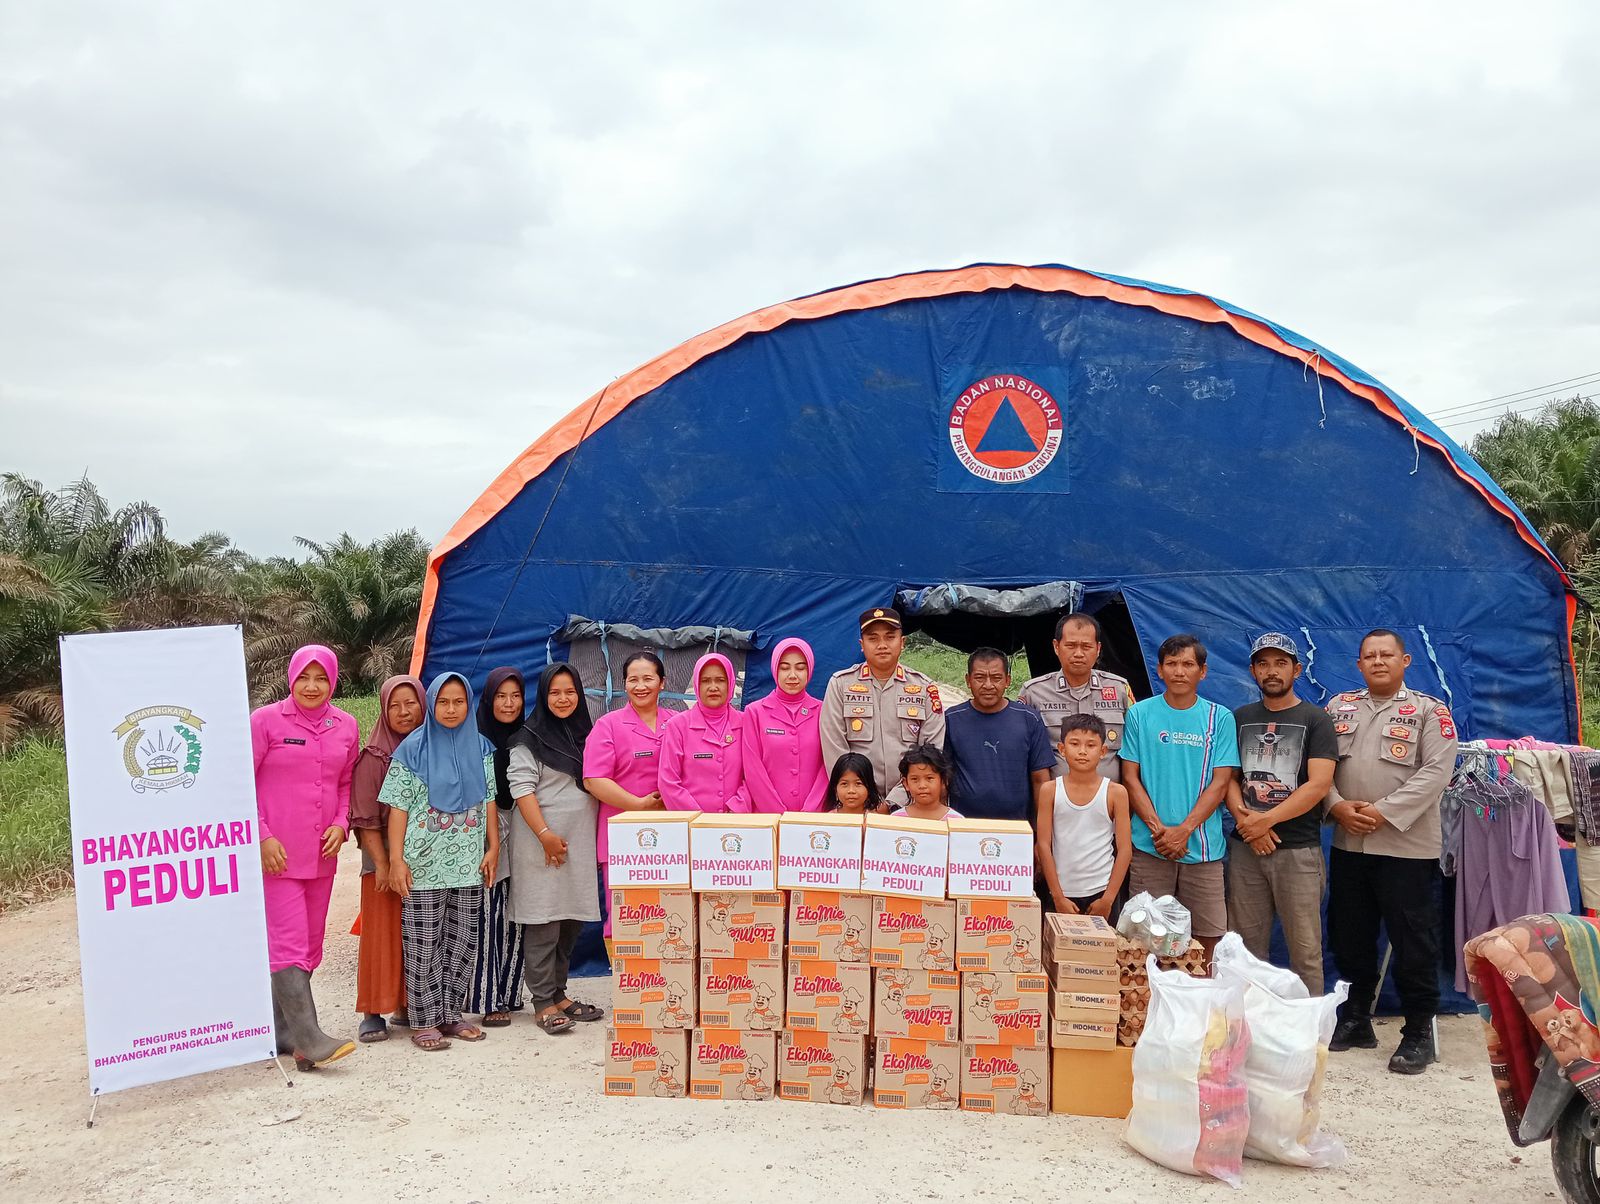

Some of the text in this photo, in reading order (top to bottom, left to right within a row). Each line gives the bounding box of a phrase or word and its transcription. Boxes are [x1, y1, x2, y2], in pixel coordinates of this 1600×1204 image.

[952, 377, 1059, 427] BADAN NASIONAL
[952, 434, 1058, 481] PENANGGULANGAN BENCANA
[846, 694, 924, 705] TATIT POLRI
[129, 707, 187, 722] BHAYANGKARI
[1390, 716, 1417, 726] POLRI
[1172, 732, 1204, 742] GELORA
[1172, 740, 1204, 748] INDONESIA
[82, 820, 252, 864] BHAYANGKARI
[610, 854, 688, 866] BHAYANGKARI
[692, 860, 772, 871] BHAYANGKARI
[780, 856, 860, 870] BHAYANGKARI
[628, 870, 668, 880] PEDULI
[864, 859, 944, 878] BHAYANGKARI
[950, 862, 1032, 876] BHAYANGKARI
[104, 854, 239, 911] PEDULI
[712, 875, 752, 886] PEDULI
[798, 872, 839, 884] PEDULI
[882, 876, 923, 891] PEDULI
[970, 880, 1011, 892] PEDULI
[619, 904, 666, 921] EkoMie
[796, 904, 846, 922] EkoMie
[878, 912, 928, 930] EkoMie
[964, 915, 1014, 932] EkoMie
[728, 927, 776, 943] EkoMie
[1075, 968, 1104, 976] INDOMILK
[620, 972, 666, 989] EkoMie
[706, 974, 754, 991] EkoMie
[794, 976, 843, 994] EkoMie
[1076, 996, 1104, 1004] INDOMILK
[902, 1008, 952, 1026] EkoMie
[992, 1012, 1042, 1029] EkoMie
[132, 1021, 234, 1048] PENGURUS RANTING
[1072, 1024, 1102, 1032] INDOMILK
[94, 1026, 270, 1068] BHAYANGKARI PANGKALAN KERINCI
[611, 1041, 658, 1058] EkoMie
[698, 1044, 747, 1060] EkoMie
[787, 1046, 835, 1063] EkoMie
[882, 1053, 932, 1070] EkoMie
[969, 1058, 1020, 1074] EkoMie
